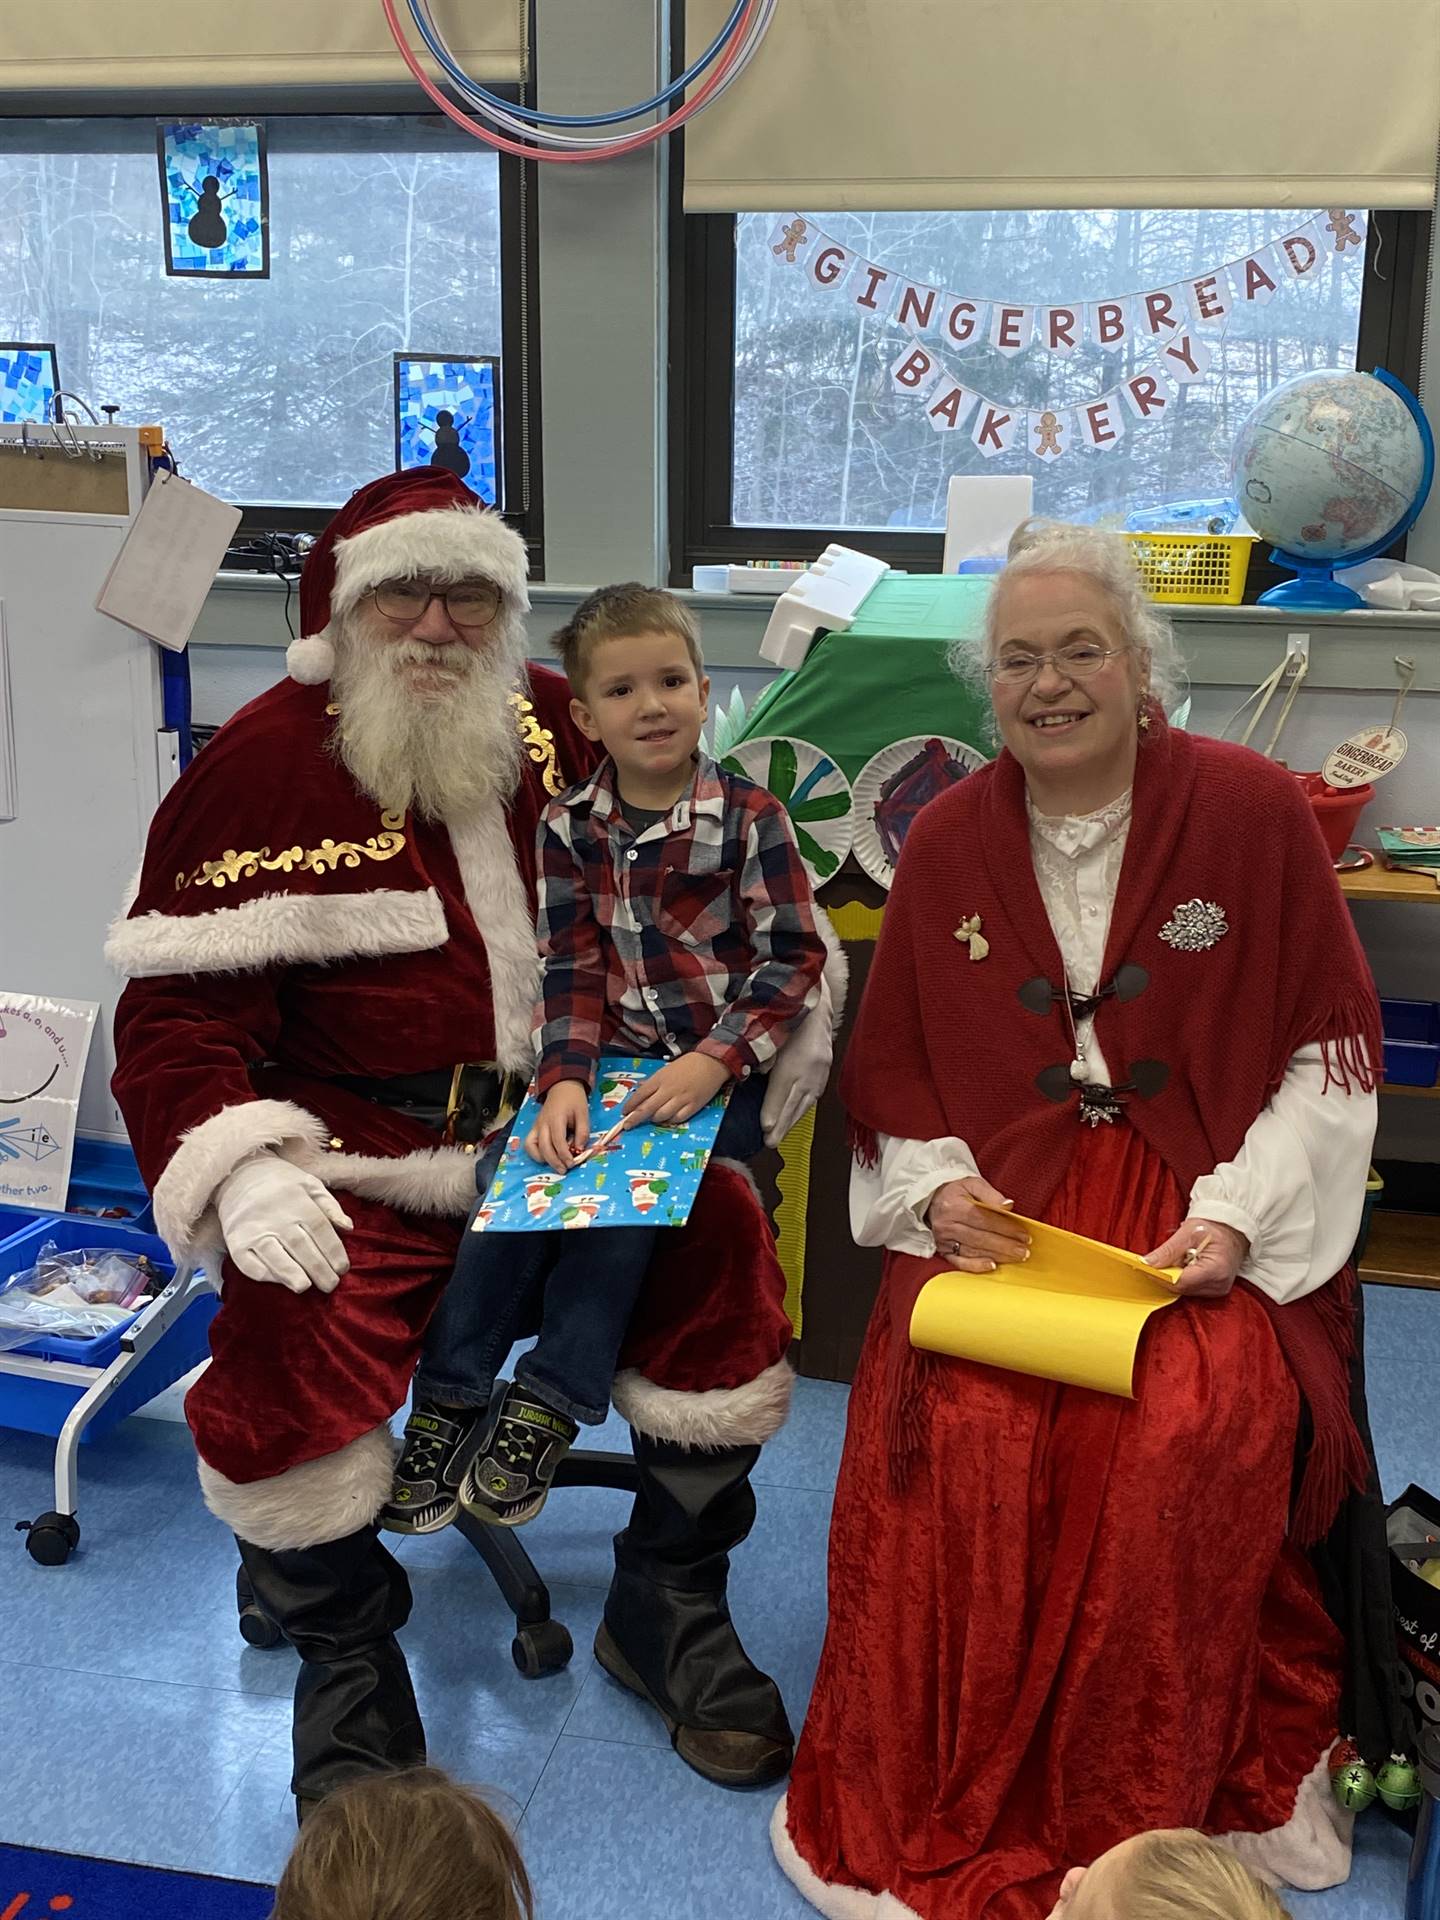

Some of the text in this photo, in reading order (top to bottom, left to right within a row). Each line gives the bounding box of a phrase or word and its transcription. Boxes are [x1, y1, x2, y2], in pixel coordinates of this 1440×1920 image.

[814, 236, 1316, 348] GINGERBREAD
[895, 336, 1199, 450] BAKERY
[1334, 760, 1369, 777] BAKERY
[1336, 743, 1394, 771] GINGERBREAD
[44, 1026, 65, 1045] and
[31, 1128, 50, 1143] i e
